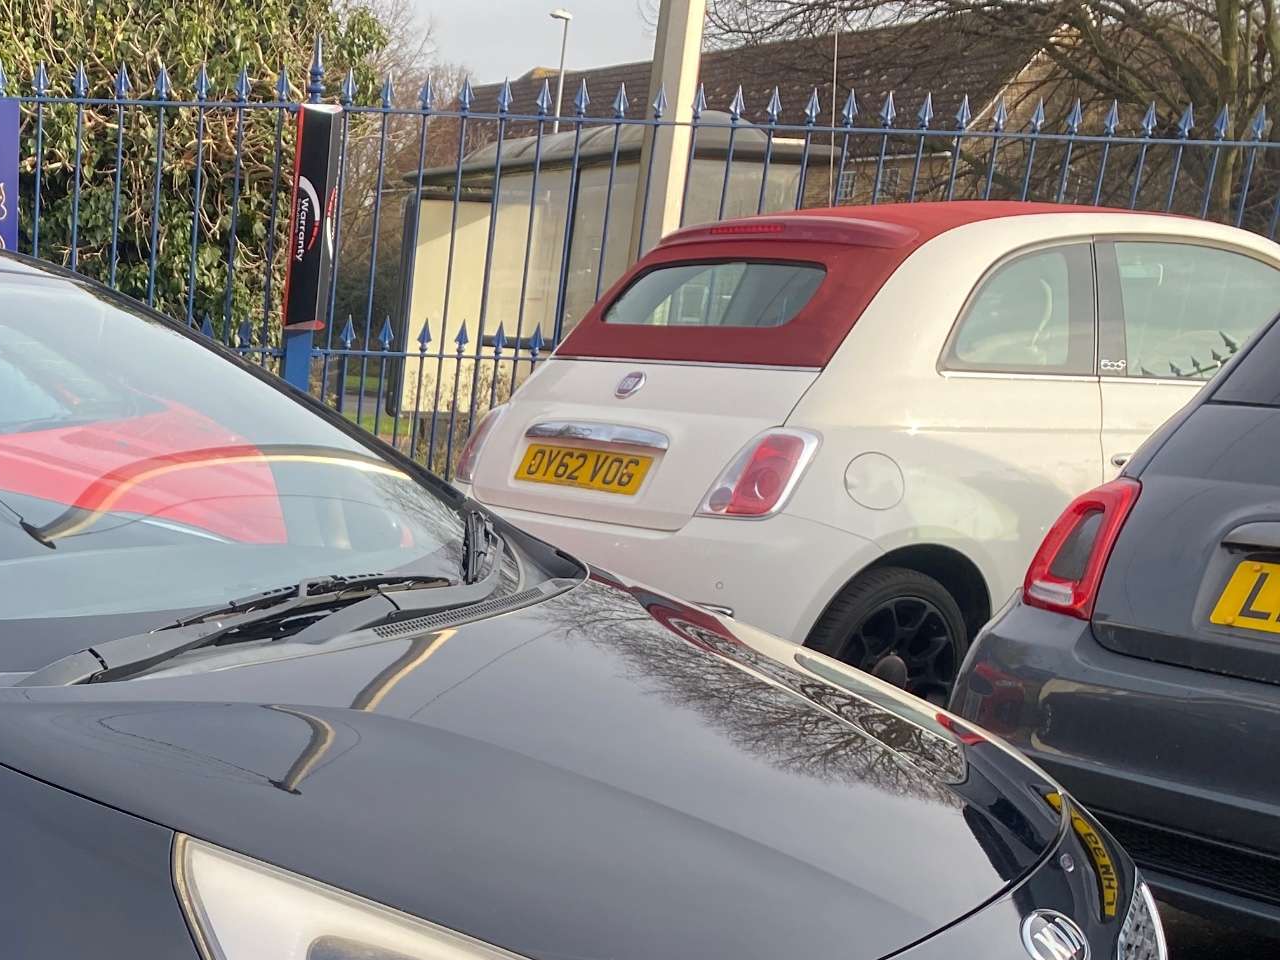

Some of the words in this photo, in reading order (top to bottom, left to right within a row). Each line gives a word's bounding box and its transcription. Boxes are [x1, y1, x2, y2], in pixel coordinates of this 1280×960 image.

[295, 197, 309, 262] Warranty
[526, 448, 587, 480] OY62
[590, 454, 640, 487] VOG
[1239, 571, 1280, 623] L
